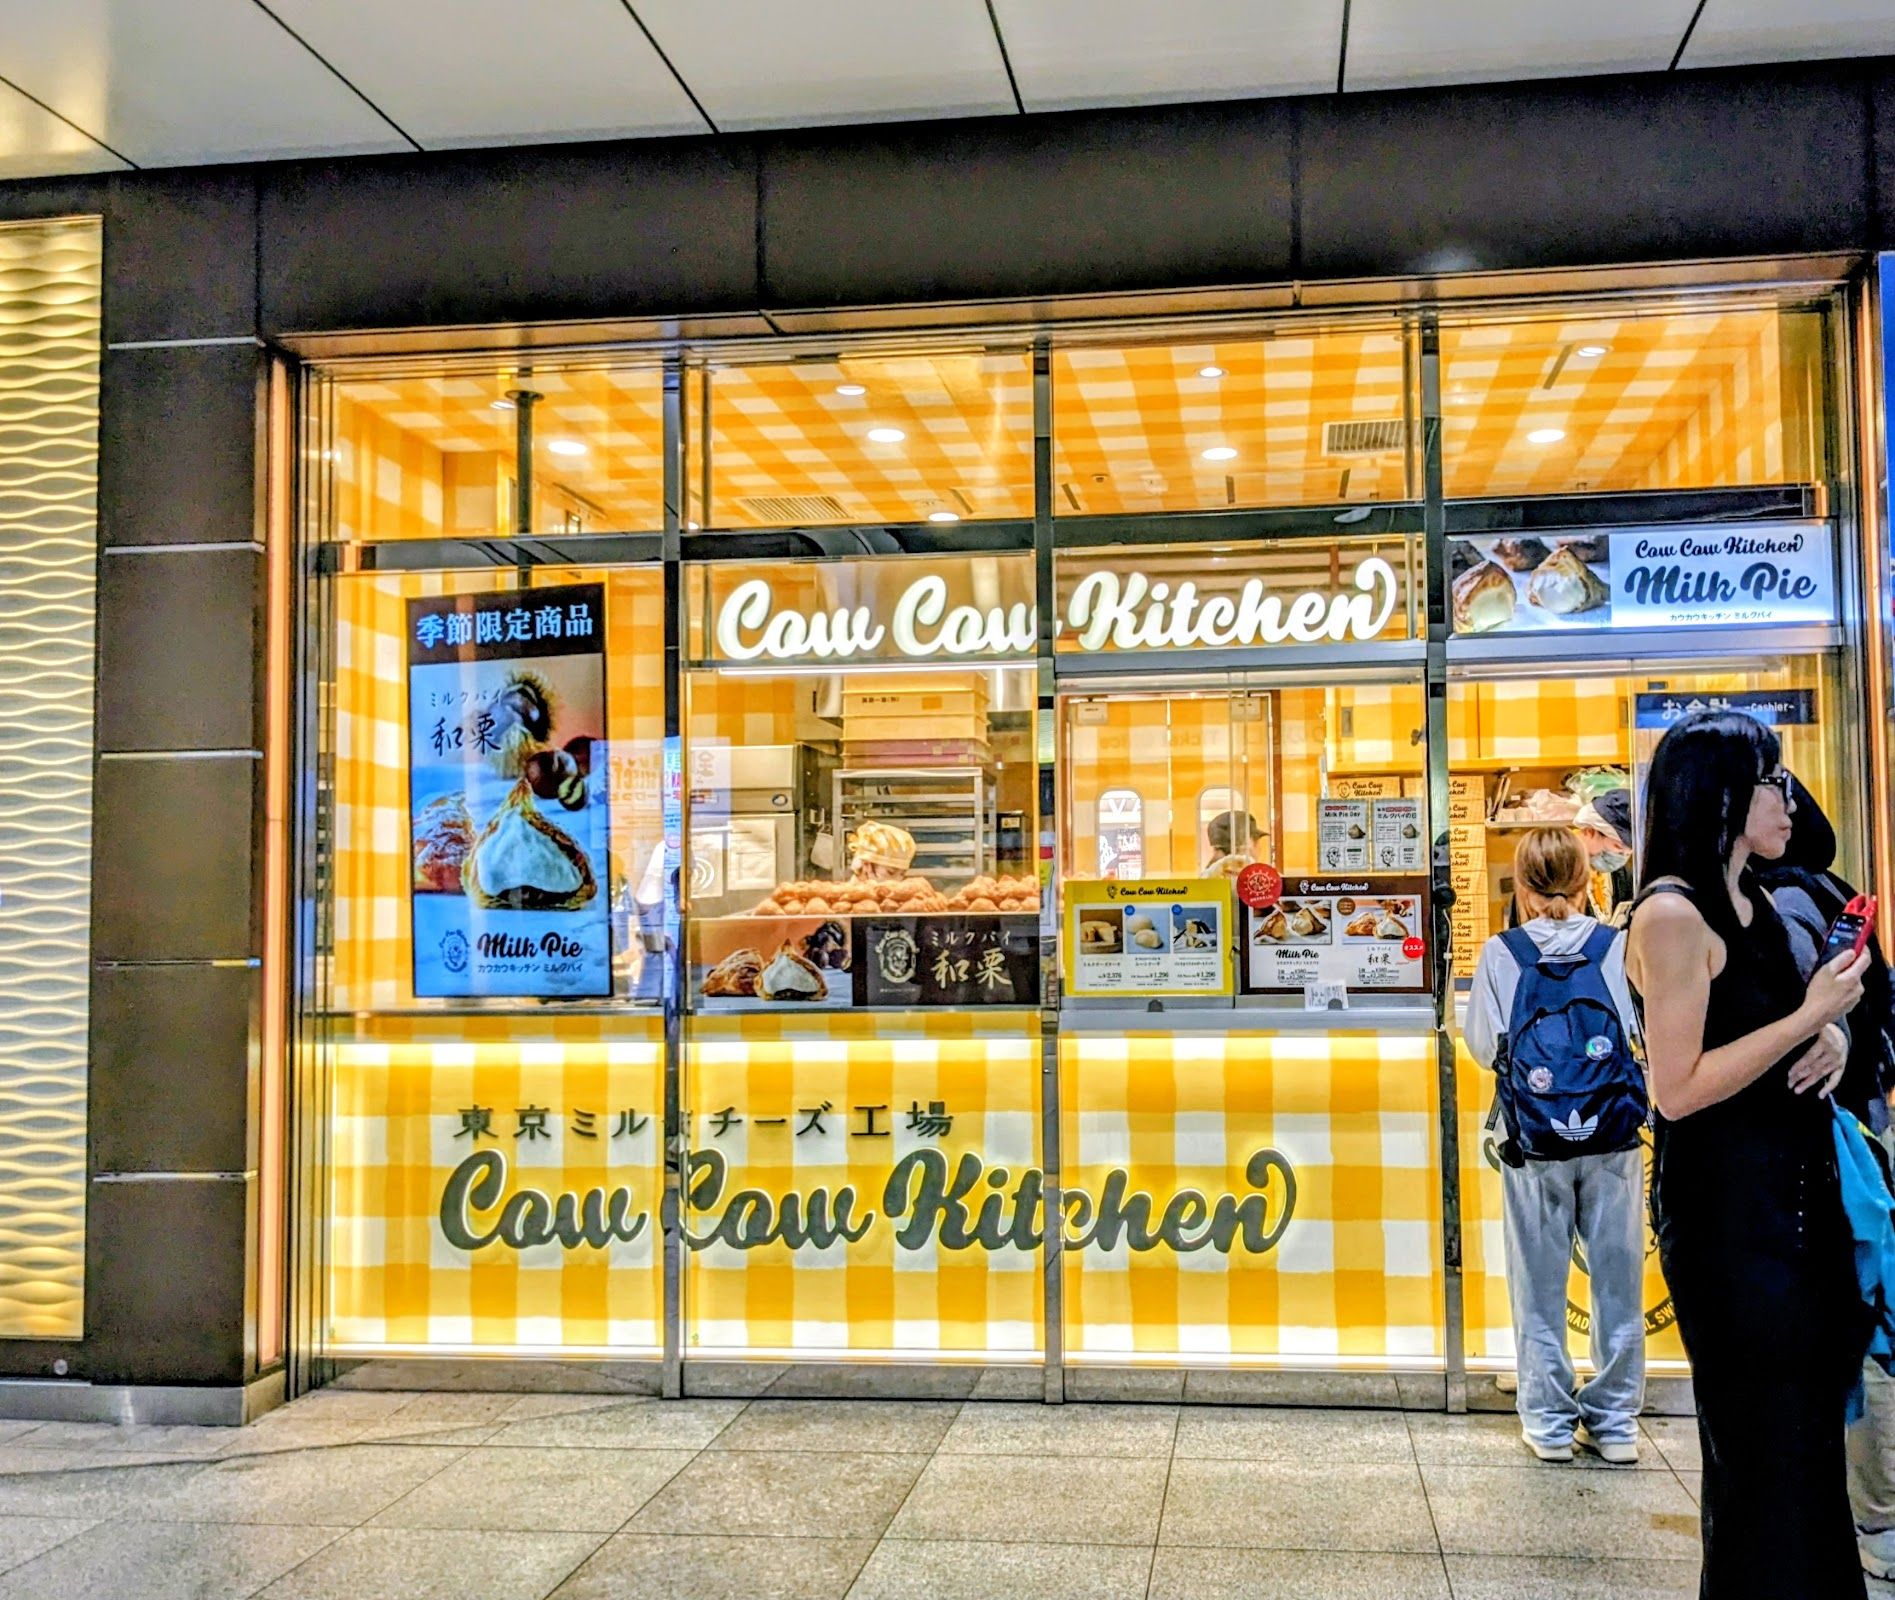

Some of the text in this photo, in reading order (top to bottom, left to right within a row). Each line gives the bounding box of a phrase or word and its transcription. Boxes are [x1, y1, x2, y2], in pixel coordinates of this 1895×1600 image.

[1635, 533, 1804, 559] Cow Cow Kitchen
[1624, 562, 1817, 605] Milk Pie
[718, 557, 1397, 659] Cow Cow Kitchen
[416, 603, 593, 649] 季節限定商品
[430, 713, 501, 756] 和栗
[1120, 886, 1188, 896] Cow Cow Kitchen
[1341, 883, 1369, 891] Kitchen
[477, 932, 538, 958] Milk
[541, 932, 583, 957] Pie
[1276, 949, 1319, 959] Milk Pie
[478, 964, 540, 974] カウカウキッチン
[930, 947, 1012, 990] 和栗
[441, 1146, 1297, 1254] Cow Cow Kitchen
[1566, 1308, 1591, 1331] MAD
